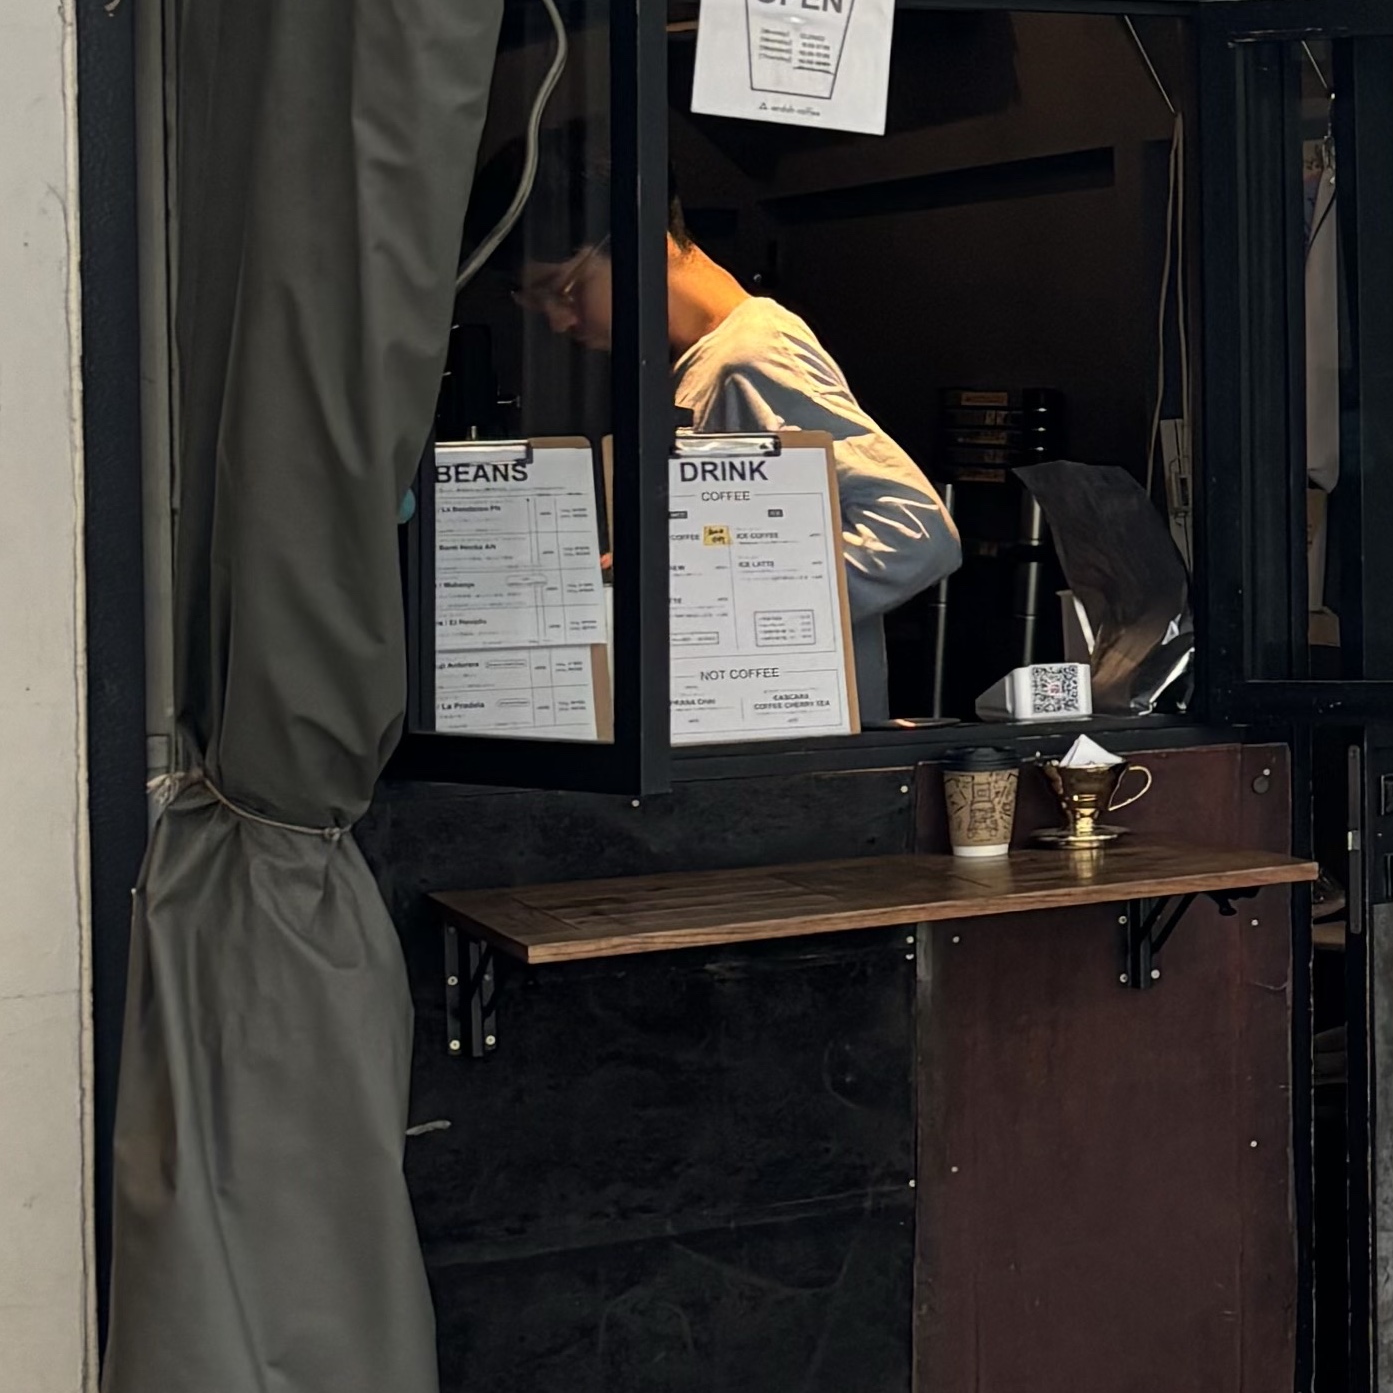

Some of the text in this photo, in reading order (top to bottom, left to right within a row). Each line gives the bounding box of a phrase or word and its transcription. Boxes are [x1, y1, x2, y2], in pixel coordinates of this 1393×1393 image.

[435, 463, 528, 483] BEANS
[679, 460, 768, 483] DRINK
[701, 491, 751, 502] COFFEE
[700, 668, 780, 681] NOT COFFEE
